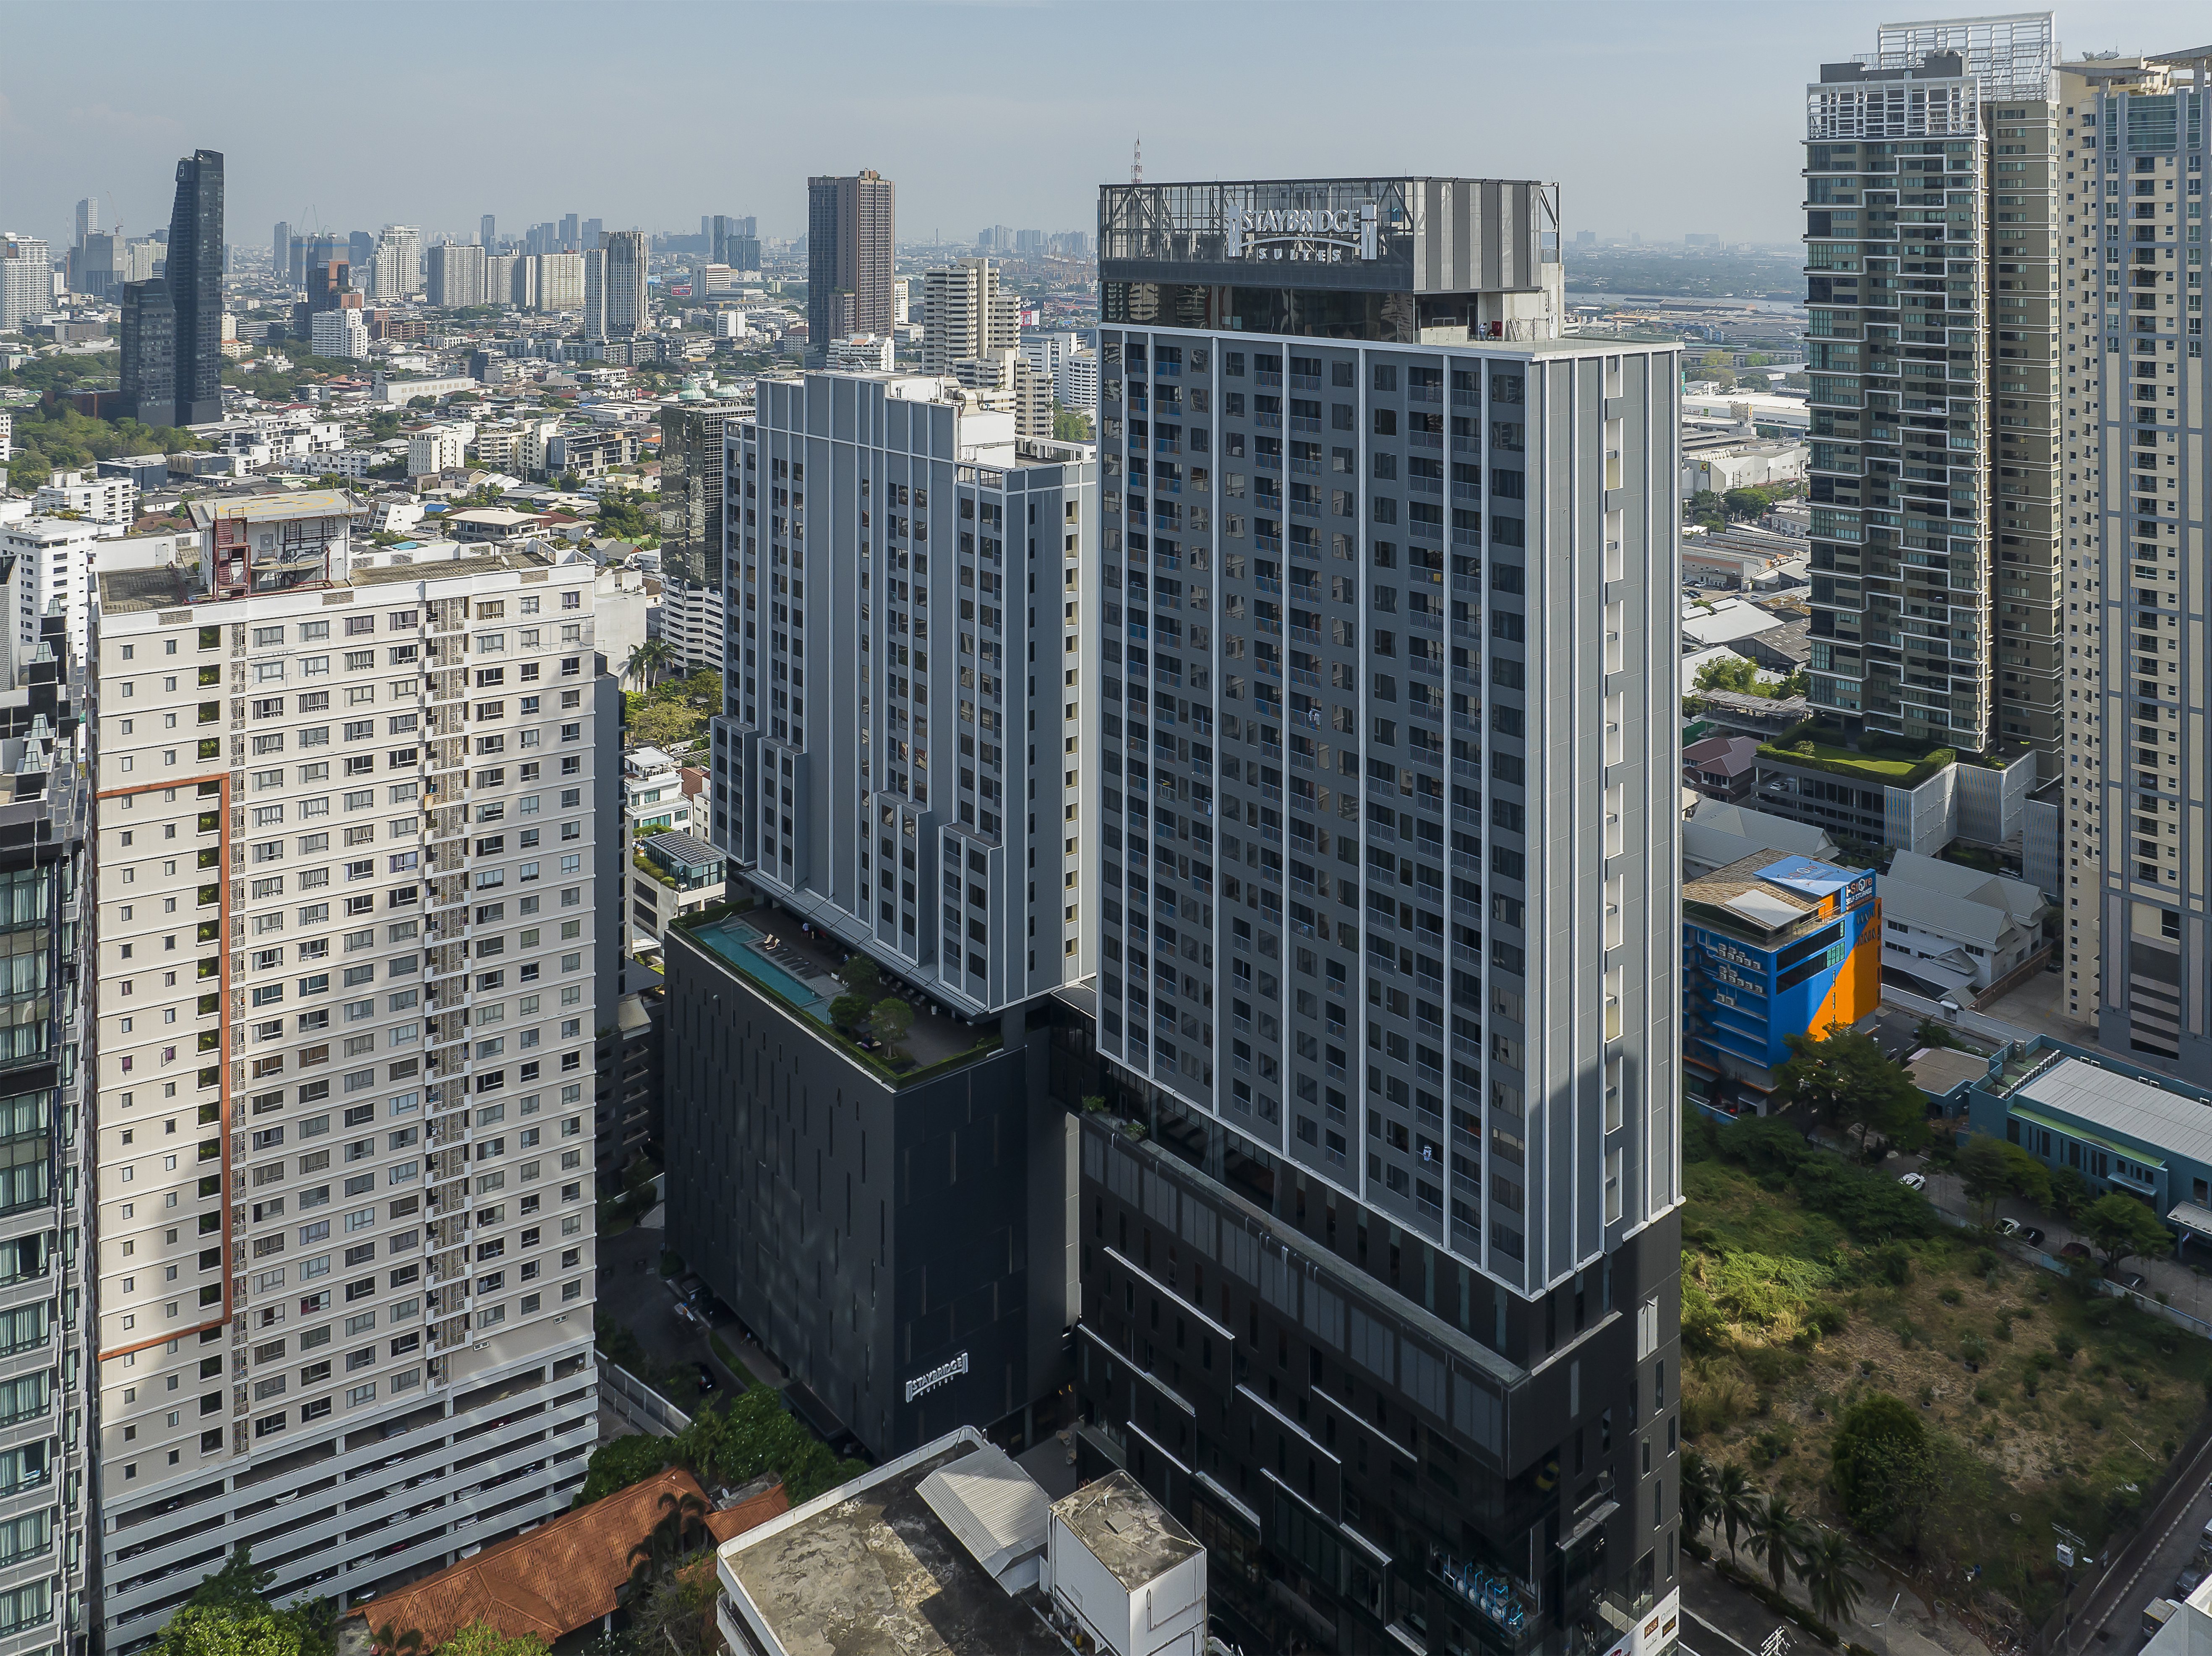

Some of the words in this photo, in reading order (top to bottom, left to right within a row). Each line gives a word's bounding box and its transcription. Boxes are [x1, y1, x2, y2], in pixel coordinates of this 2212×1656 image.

[1242, 210, 1361, 232] STAYBRIDGE
[1259, 248, 1341, 261] SUITES
[912, 1357, 962, 1390] STAYBRIDGE
